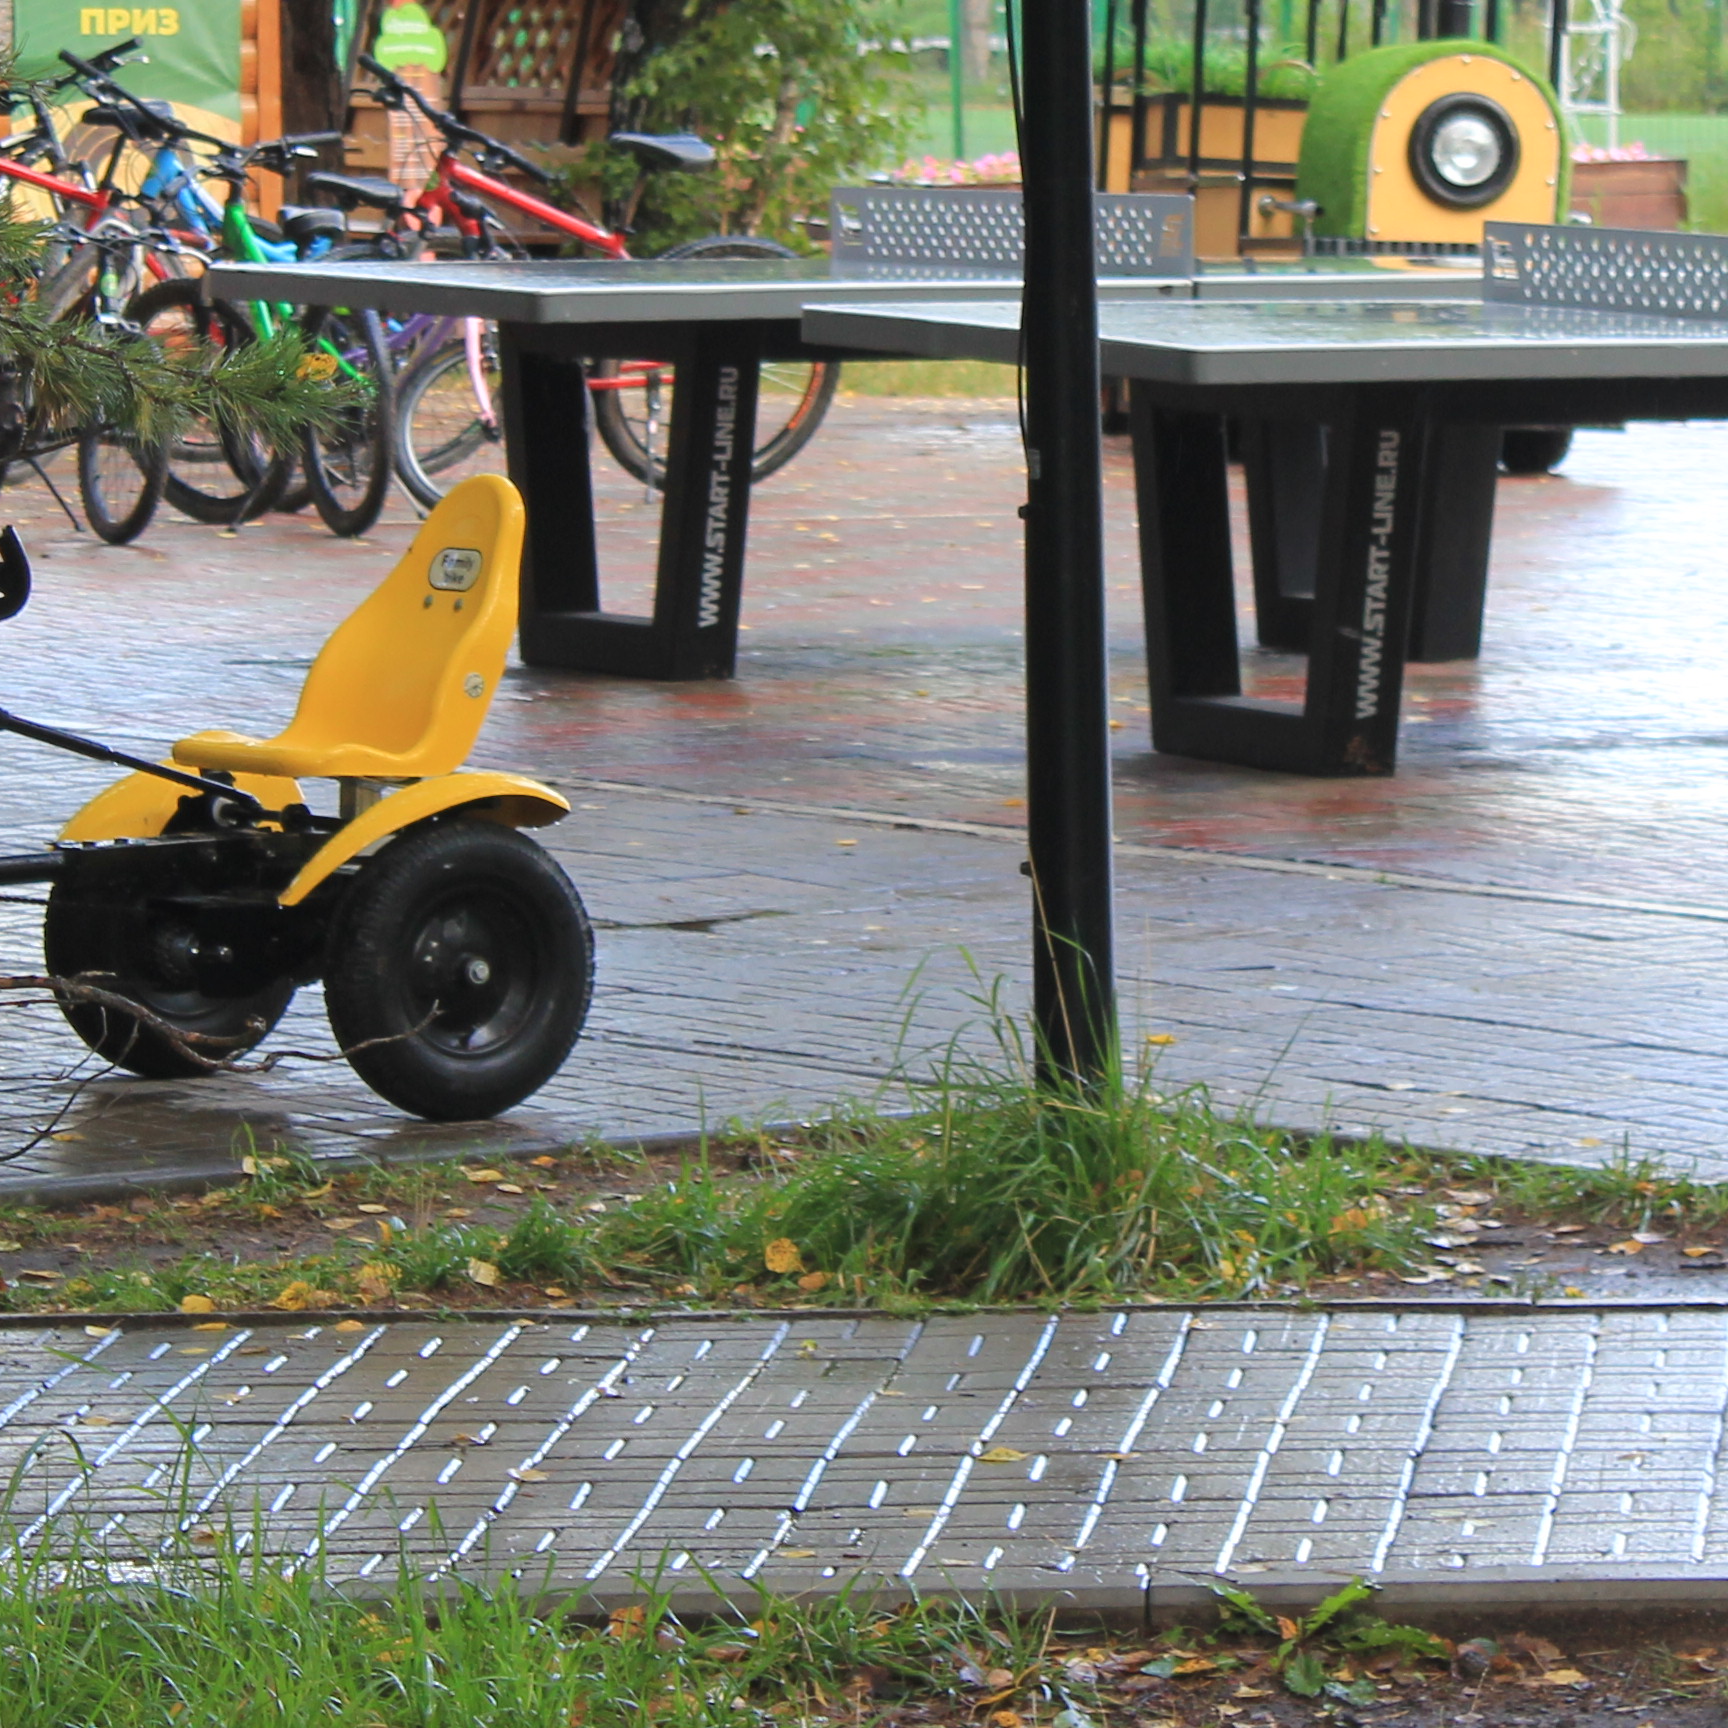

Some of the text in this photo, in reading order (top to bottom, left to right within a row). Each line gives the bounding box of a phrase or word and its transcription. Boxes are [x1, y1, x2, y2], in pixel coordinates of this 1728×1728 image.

[79, 8, 180, 35] ПРИЗ
[697, 366, 739, 629] WWW.START-LINE.RU
[1355, 429, 1400, 720] WWW.START-LINE.RU
